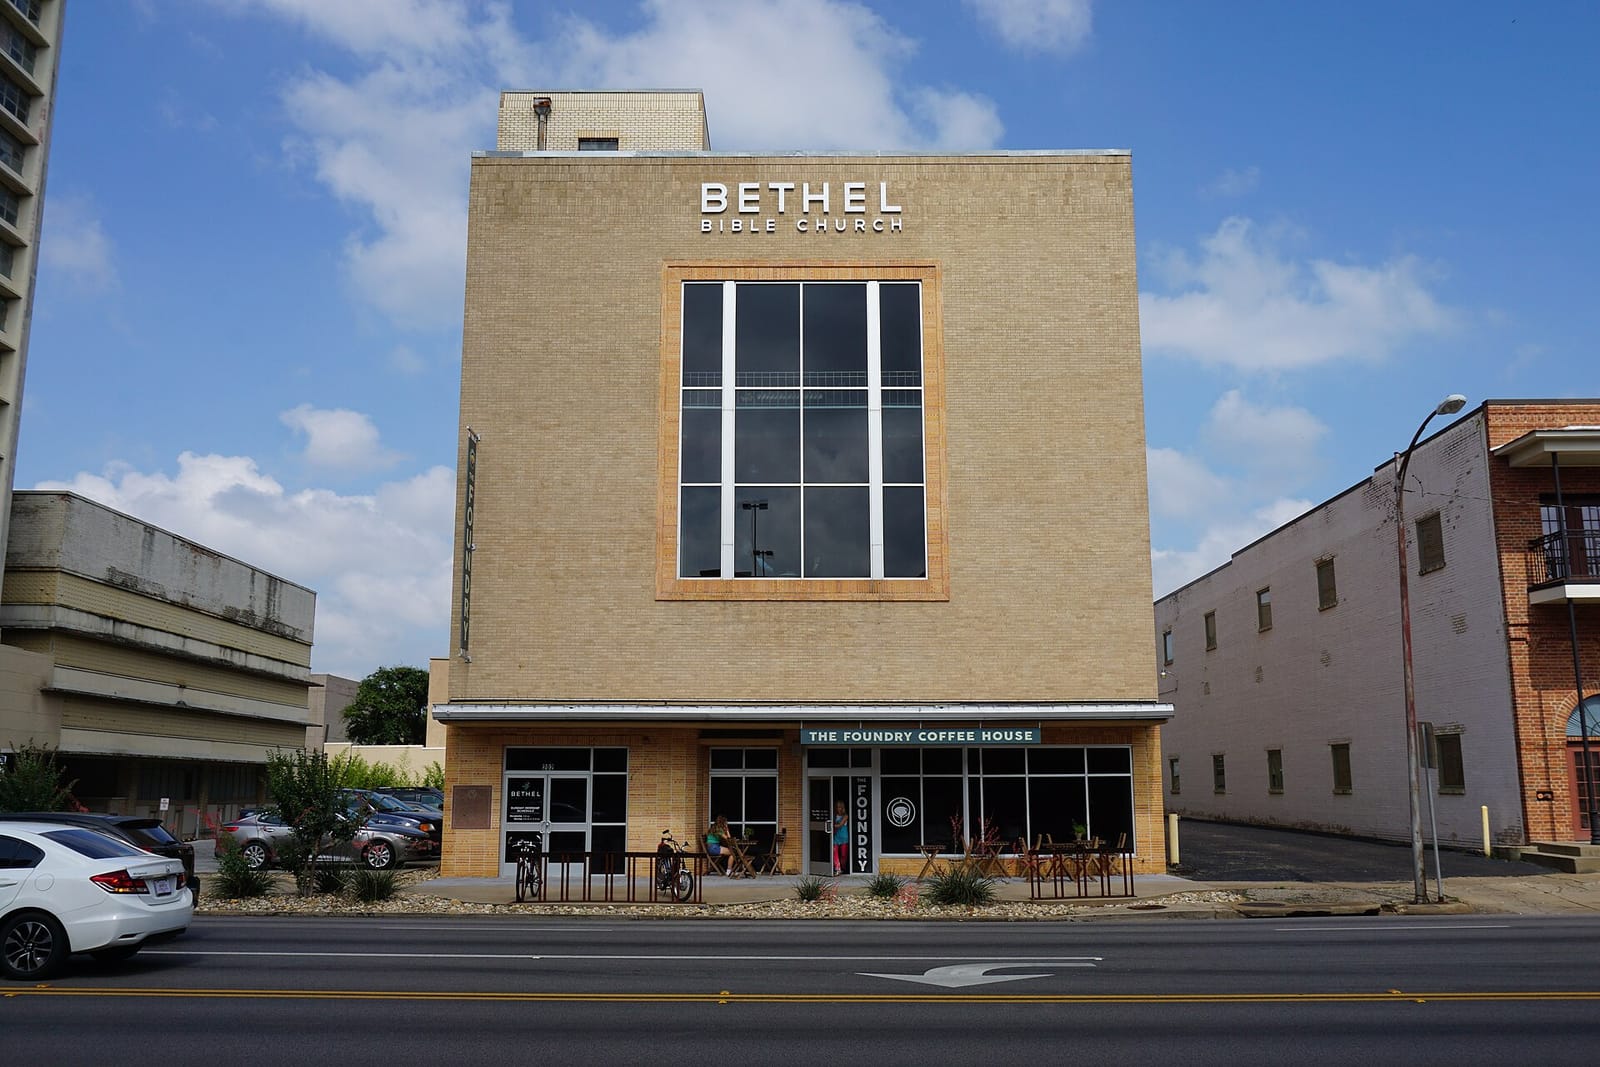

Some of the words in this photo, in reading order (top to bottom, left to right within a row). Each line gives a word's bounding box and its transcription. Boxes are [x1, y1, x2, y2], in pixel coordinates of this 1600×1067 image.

[701, 182, 902, 213] BETHEL
[701, 219, 776, 232] BIBLE
[796, 218, 903, 232] CHURCH
[463, 484, 474, 641] FOUNDRY
[809, 731, 838, 742] THE
[843, 731, 912, 742] FOUNDRY
[918, 731, 975, 742] COFFEE
[981, 730, 1034, 741] HOUSE
[856, 784, 868, 872] FOUNDRY
